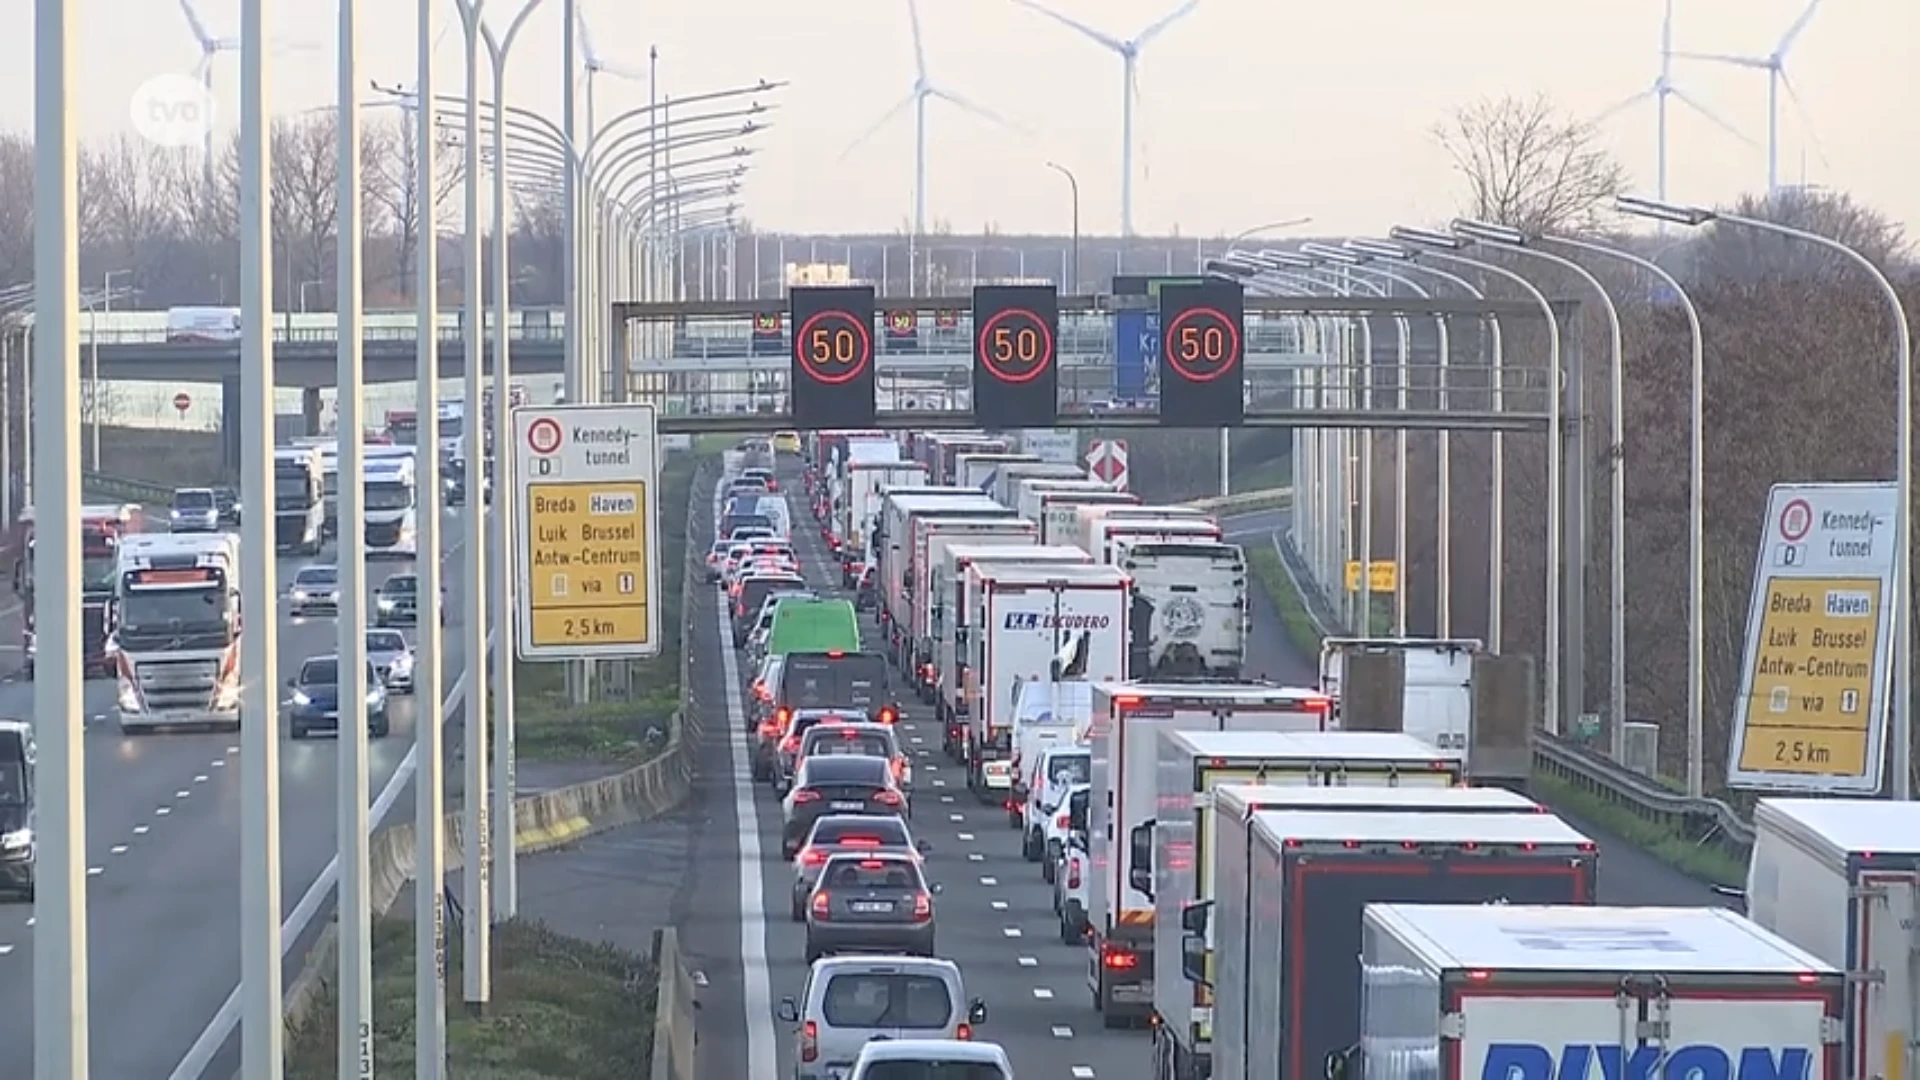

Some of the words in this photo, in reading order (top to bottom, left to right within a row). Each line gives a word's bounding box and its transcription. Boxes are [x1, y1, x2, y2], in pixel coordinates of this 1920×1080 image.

[812, 329, 854, 364] 50
[994, 328, 1036, 361] 50
[1181, 327, 1222, 361] 50
[573, 425, 638, 446] Kennedy-
[539, 458, 551, 475] D
[586, 448, 630, 466] tunnel
[535, 495, 576, 514] Breda
[591, 495, 634, 512] Haven
[539, 524, 567, 542] Luik
[582, 522, 634, 541] Brussel
[1821, 509, 1883, 534] Kennedy-
[1784, 546, 1797, 565] D
[1829, 537, 1872, 558] tunnel
[582, 577, 602, 593] via
[1770, 592, 1812, 613] Breda
[1827, 594, 1869, 613] Haven
[564, 618, 590, 639] 2,5
[592, 618, 615, 635] km
[1043, 614, 1109, 629] ESCUDERO
[1769, 626, 1798, 647] Luik
[1812, 627, 1867, 649] Brussel
[1802, 691, 1825, 712] via
[1775, 739, 1804, 764] 2,5
[1807, 742, 1830, 764] km
[359, 1022, 370, 1080] 313
